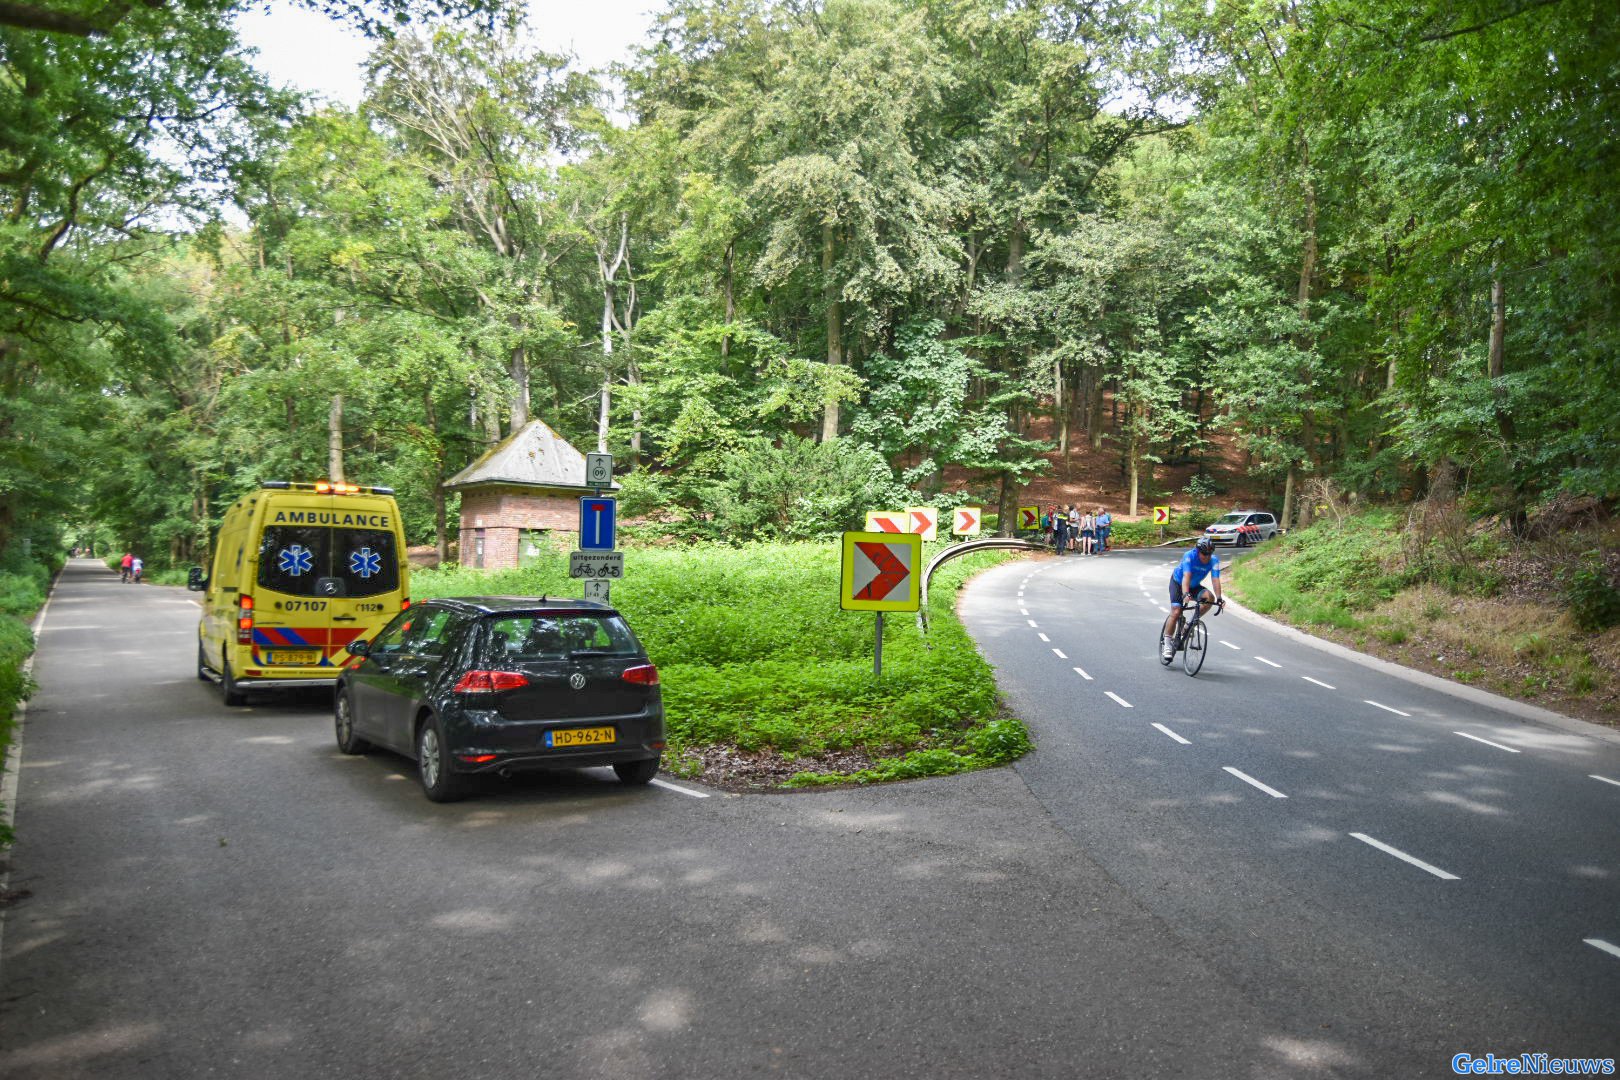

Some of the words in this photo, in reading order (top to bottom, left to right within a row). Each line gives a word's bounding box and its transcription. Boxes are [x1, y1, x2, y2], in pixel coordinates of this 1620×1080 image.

[275, 512, 389, 528] AMBULANCE
[285, 601, 327, 611] 07107
[554, 730, 613, 744] HD-962-N
